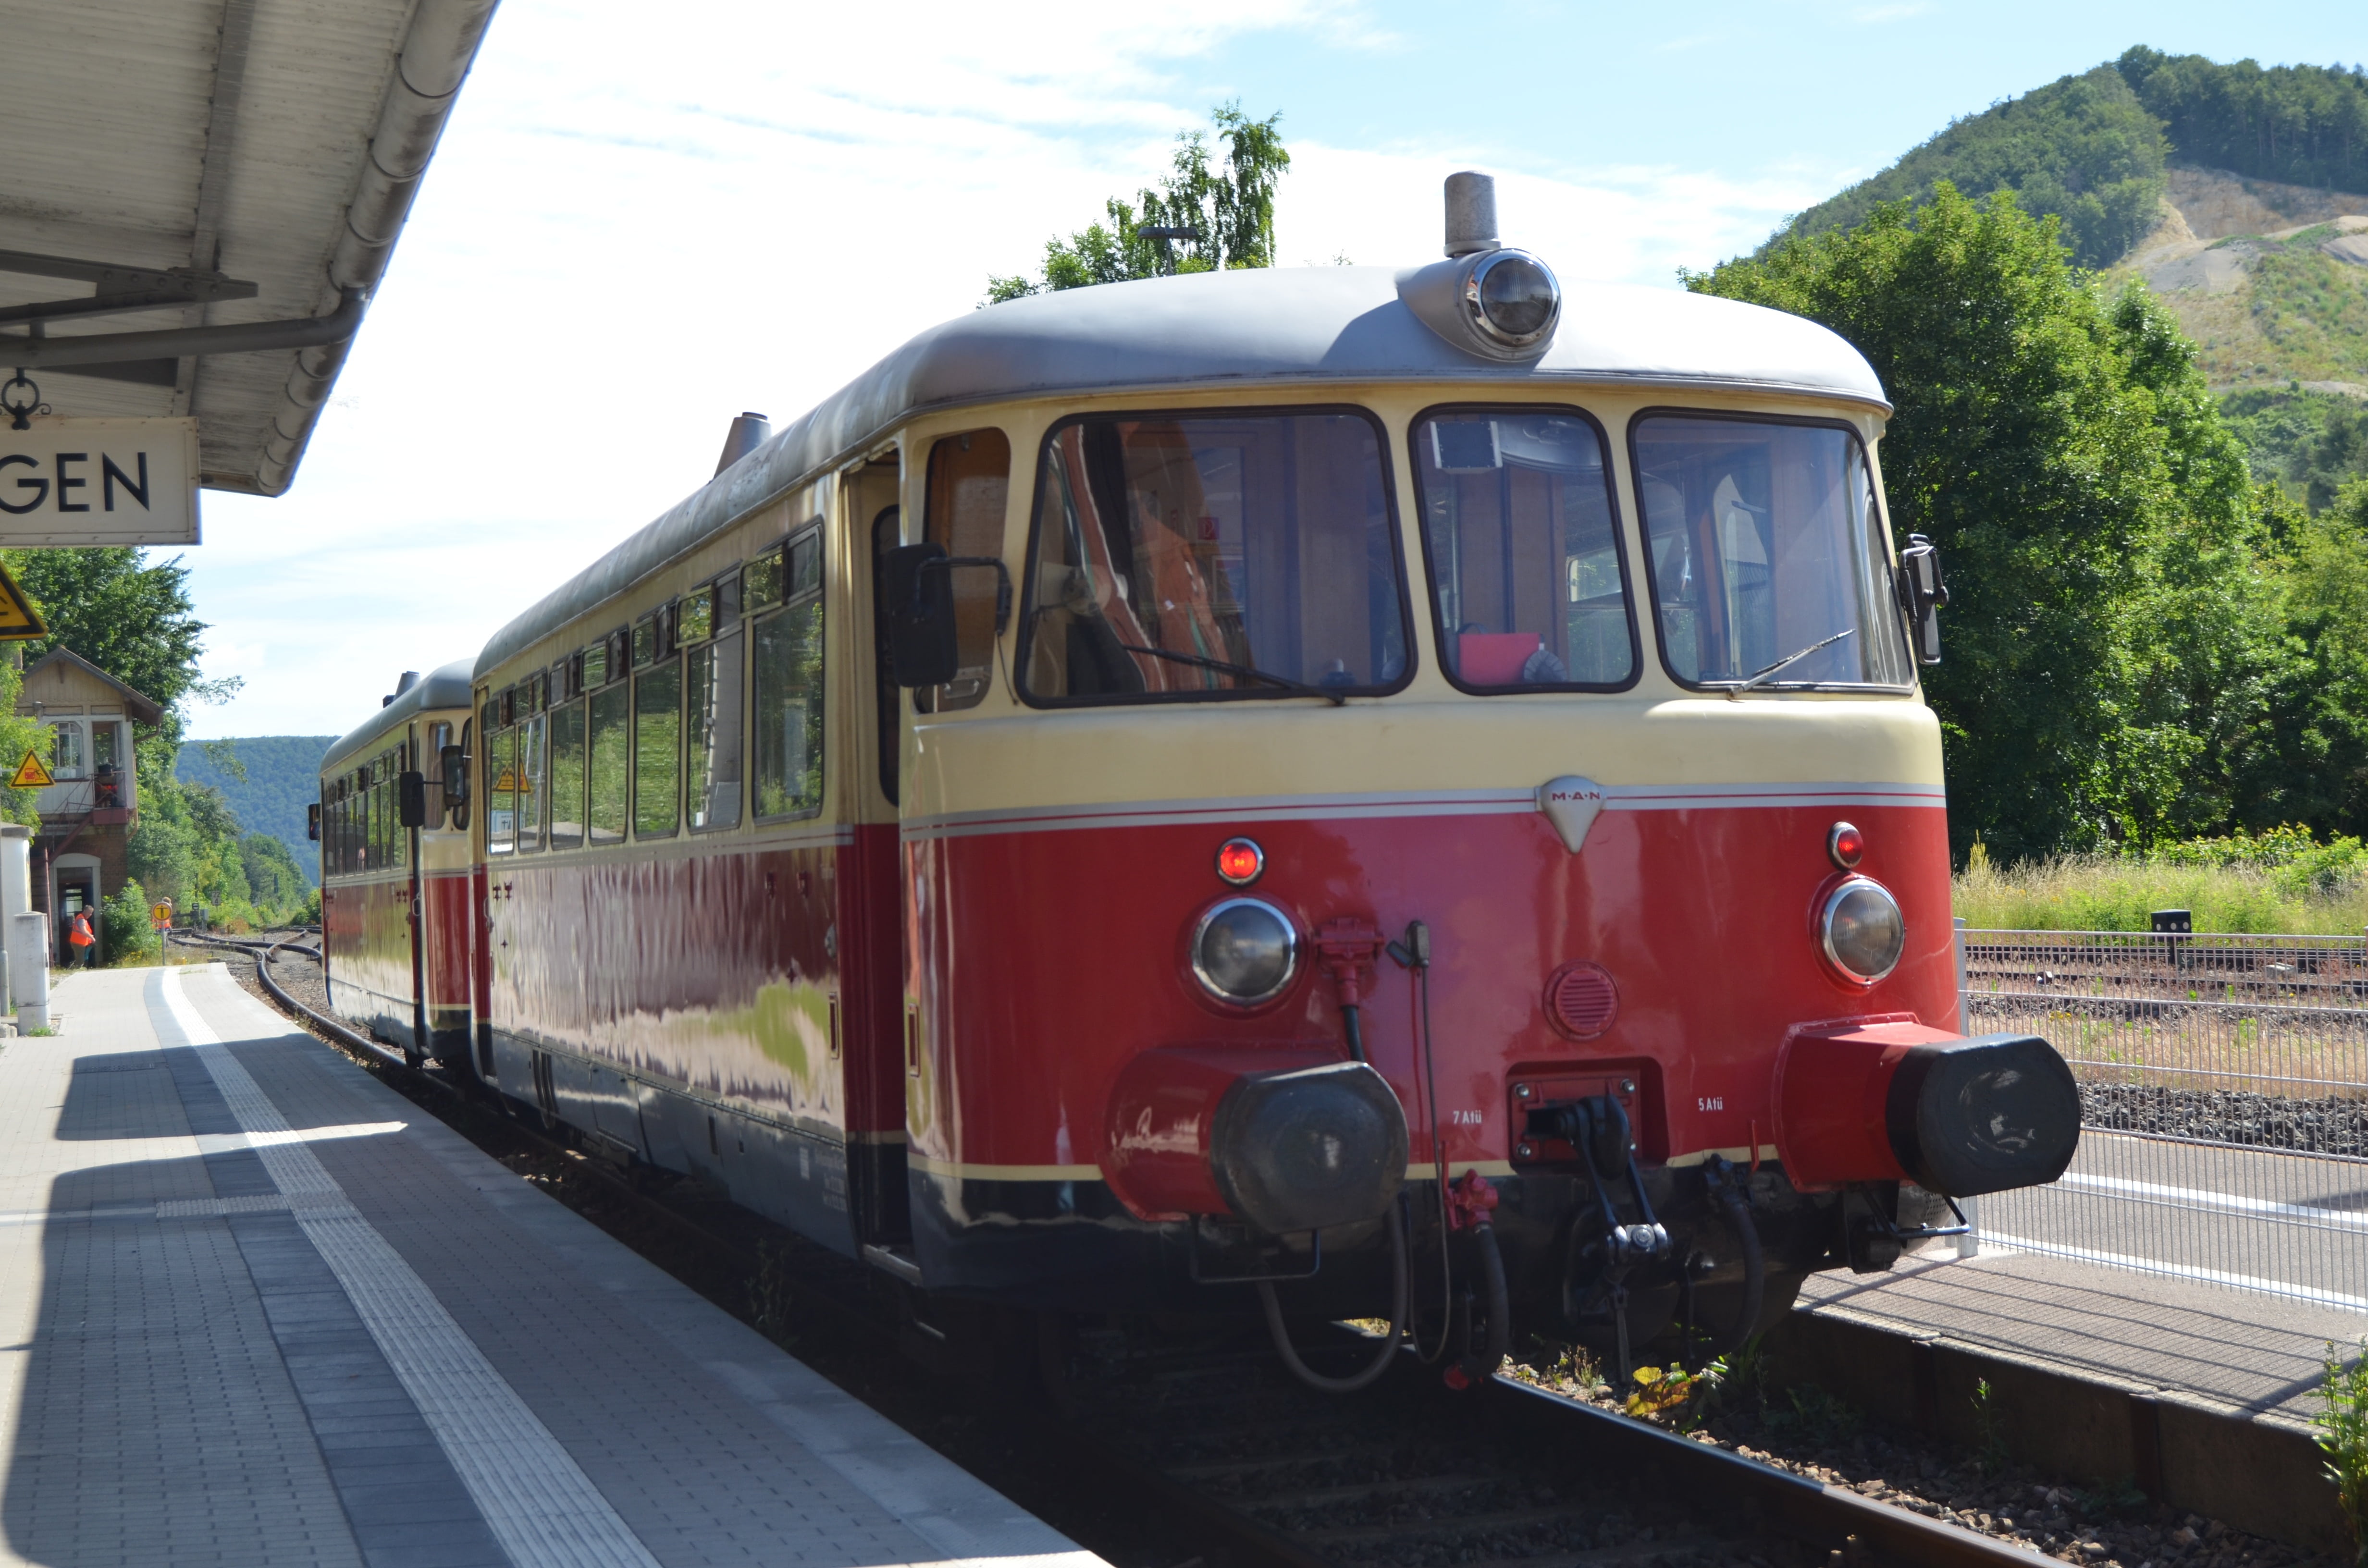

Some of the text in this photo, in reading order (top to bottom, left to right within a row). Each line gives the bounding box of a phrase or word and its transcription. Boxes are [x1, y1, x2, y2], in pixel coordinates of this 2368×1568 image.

[0, 452, 149, 514] GEN
[1699, 1097, 1723, 1111] 5 Atü
[1454, 1109, 1481, 1124] 7 Atü
